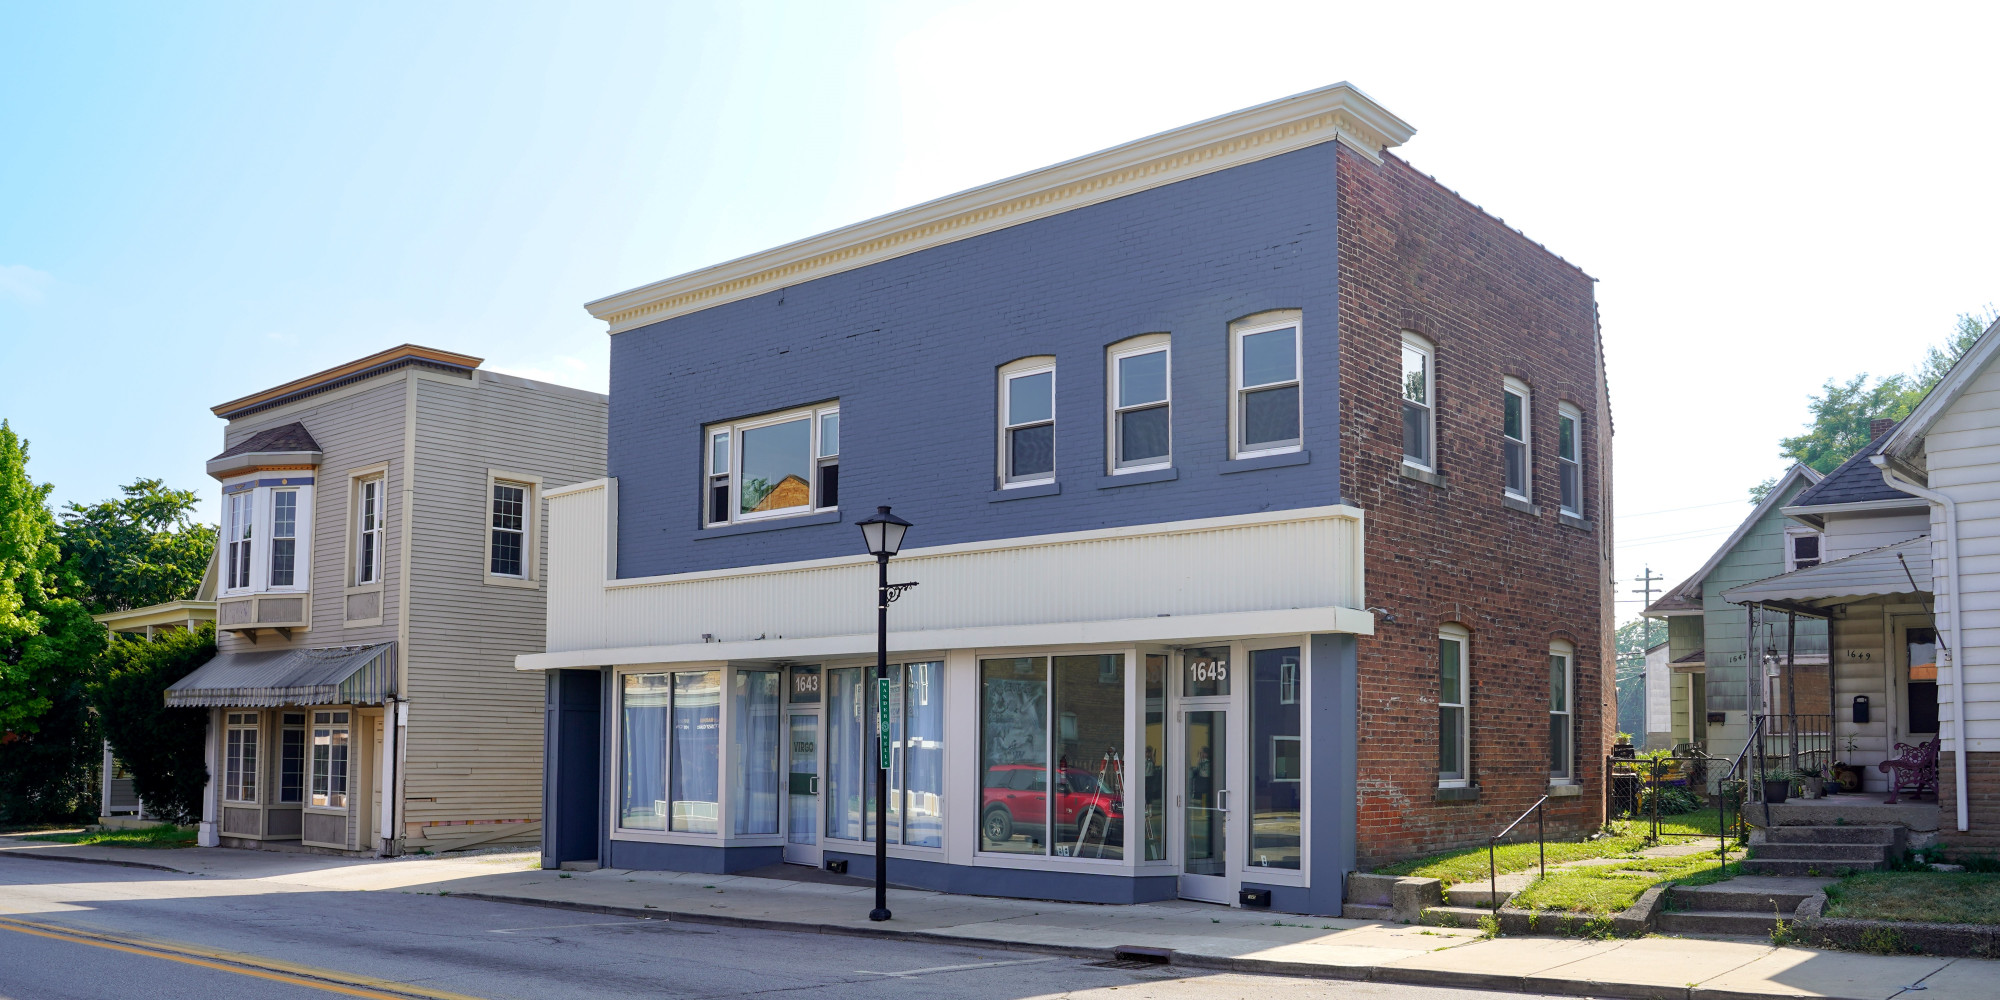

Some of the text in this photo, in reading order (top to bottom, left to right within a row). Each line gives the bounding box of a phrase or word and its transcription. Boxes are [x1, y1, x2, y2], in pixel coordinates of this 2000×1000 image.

[1729, 653, 1747, 663] 1647
[1847, 649, 1871, 661] 1649
[1190, 660, 1227, 682] 1645
[795, 675, 818, 692] 1643
[793, 741, 814, 753] VIRGO
